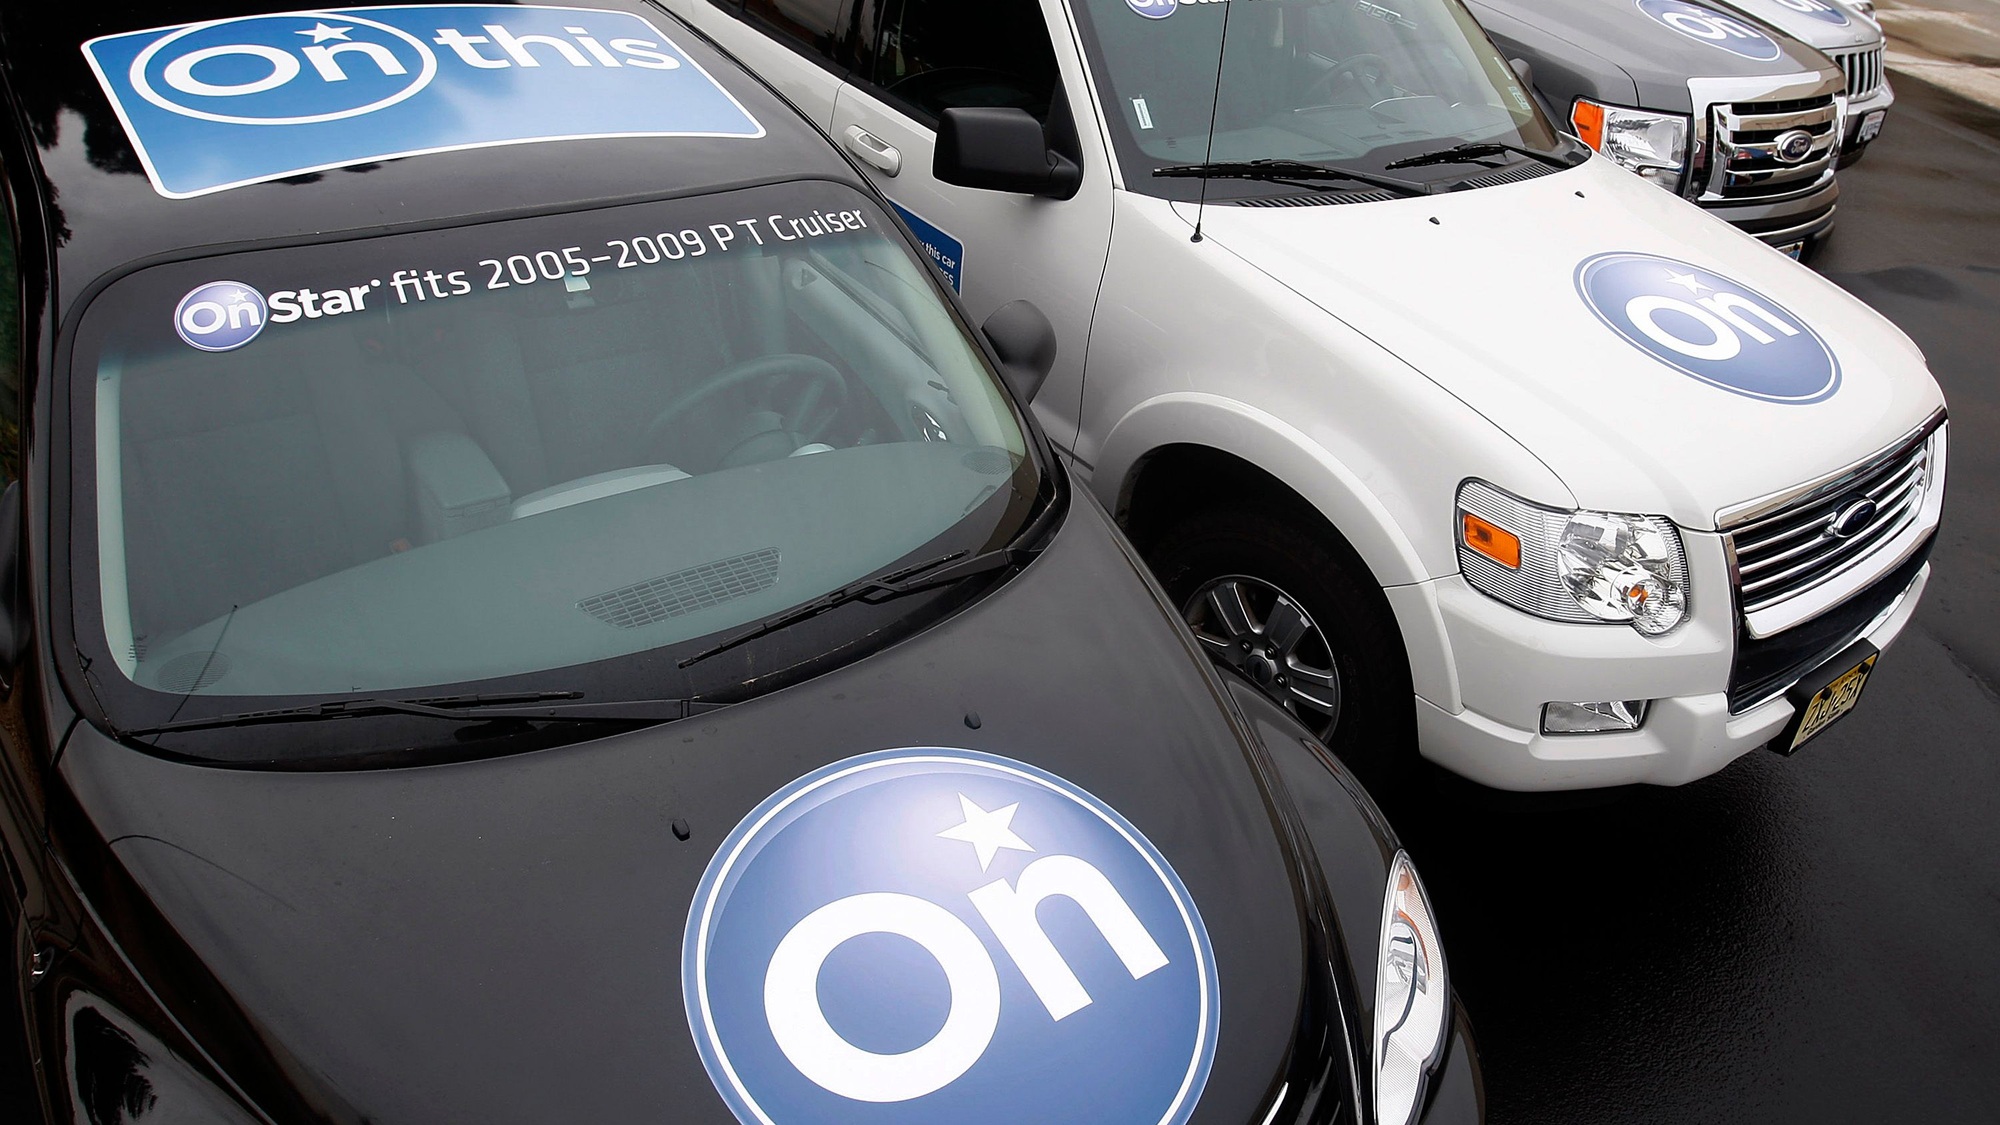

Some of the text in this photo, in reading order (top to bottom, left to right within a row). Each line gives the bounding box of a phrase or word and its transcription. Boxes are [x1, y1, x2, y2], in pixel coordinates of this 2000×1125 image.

[163, 25, 681, 97] On this
[1662, 12, 1761, 40] On
[390, 270, 472, 304] fits
[768, 207, 868, 243] Cruiser
[925, 242, 956, 270] this car
[1625, 291, 1800, 361] On
[763, 854, 1171, 1103] On
